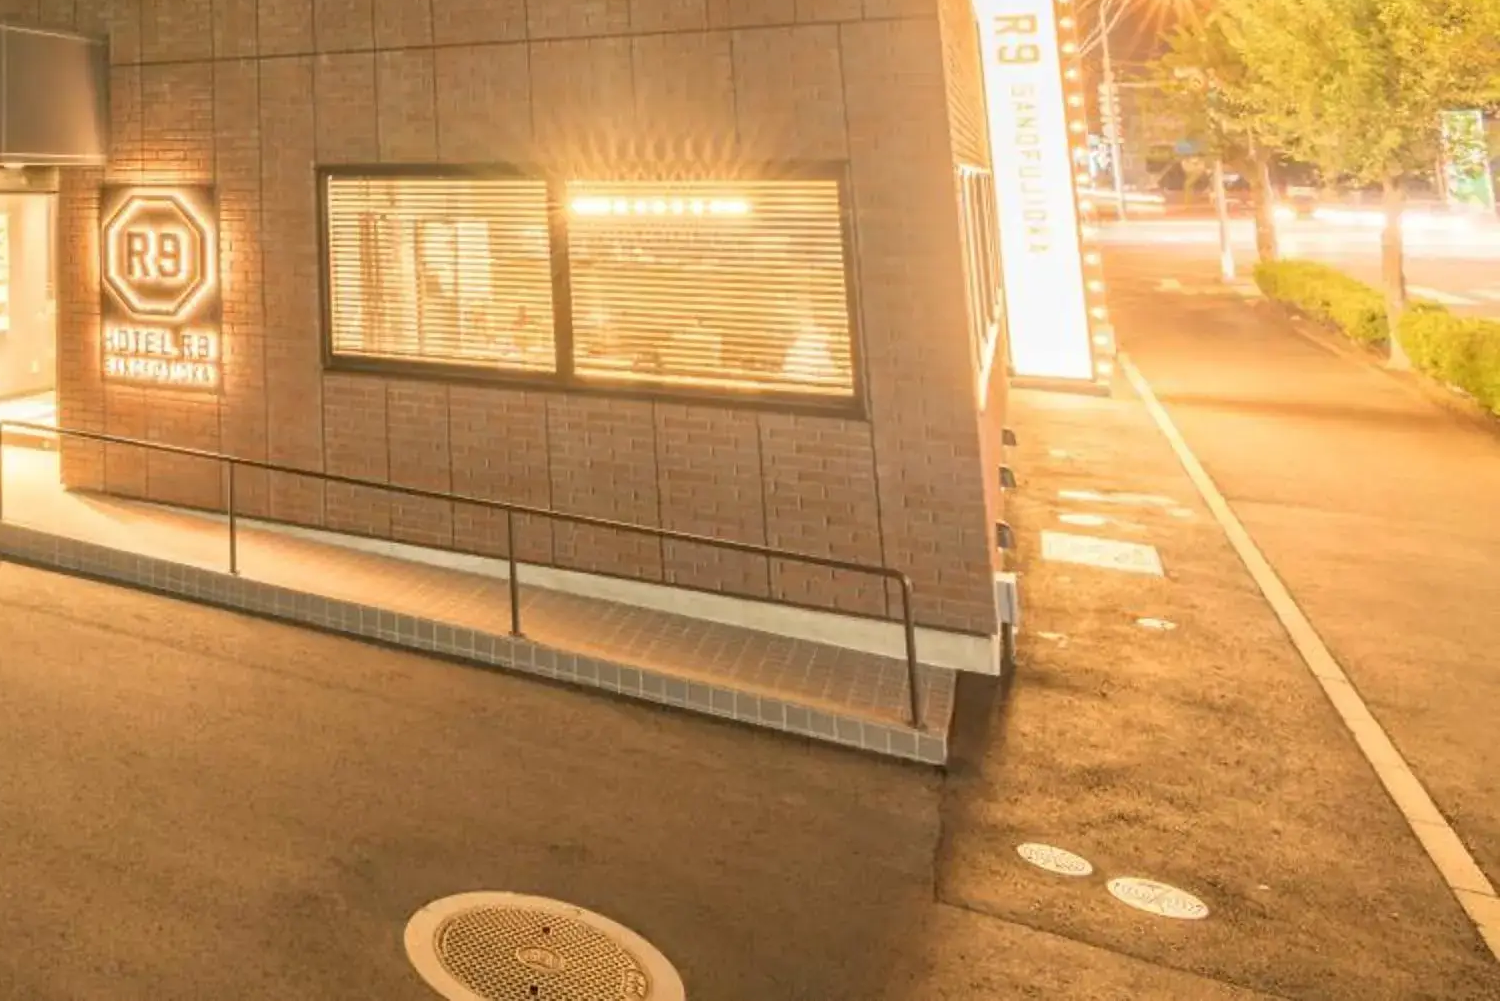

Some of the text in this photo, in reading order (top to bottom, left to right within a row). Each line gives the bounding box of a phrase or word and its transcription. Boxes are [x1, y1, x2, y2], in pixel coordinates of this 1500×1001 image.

[992, 12, 1042, 67] R9
[126, 230, 181, 278] R9
[104, 328, 211, 358] HOTEL R9
